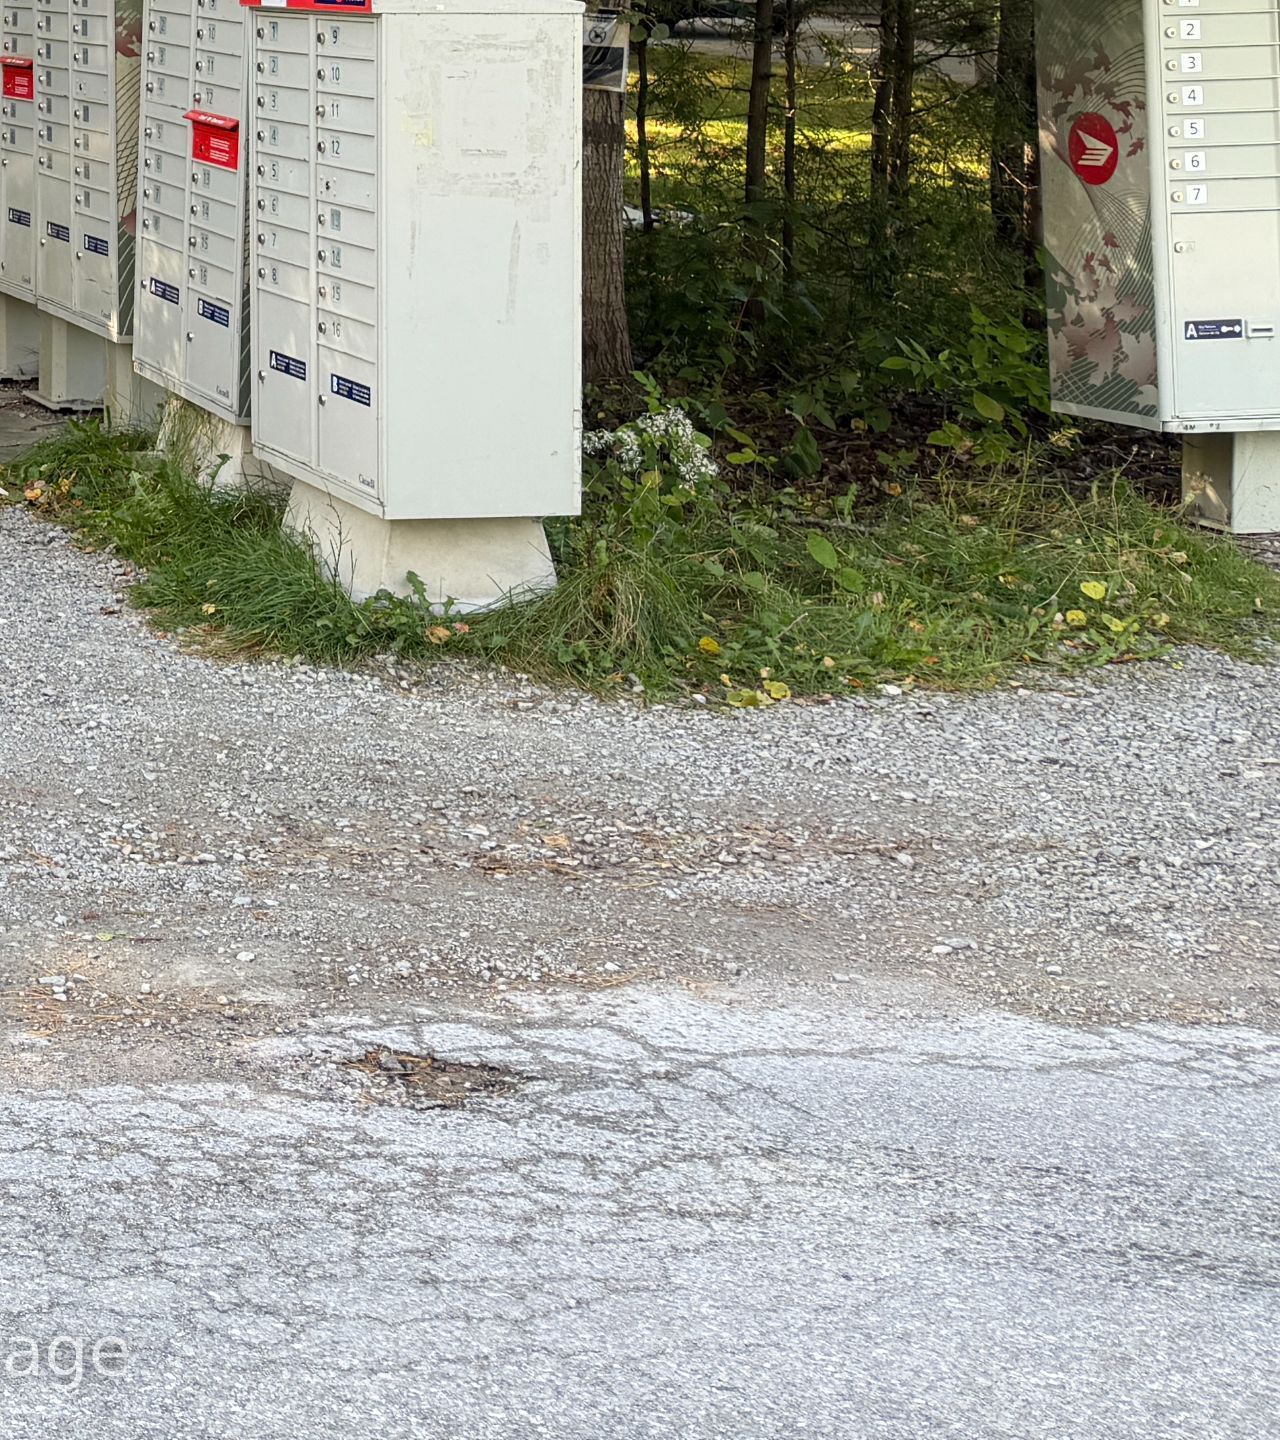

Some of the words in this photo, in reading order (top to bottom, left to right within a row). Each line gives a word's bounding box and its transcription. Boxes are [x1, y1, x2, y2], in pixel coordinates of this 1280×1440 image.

[332, 29, 338, 44] 9
[1186, 23, 1195, 36] 2
[271, 59, 277, 74] 2
[1188, 56, 1196, 69] 3
[331, 66, 340, 82] 10
[271, 94, 277, 109] 3
[1188, 89, 1197, 102] 4
[331, 103, 339, 118] 11
[271, 128, 277, 143] 4
[1190, 122, 1198, 135] 5
[331, 140, 340, 155] 12
[1191, 155, 1200, 168] 6
[271, 163, 277, 178] 5
[1193, 188, 1201, 201] 7
[271, 232, 277, 247] 7
[271, 267, 277, 282] 8
[332, 321, 341, 338] 16
[1186, 323, 1198, 338] A
[271, 352, 277, 368] A
[332, 375, 338, 392] B
